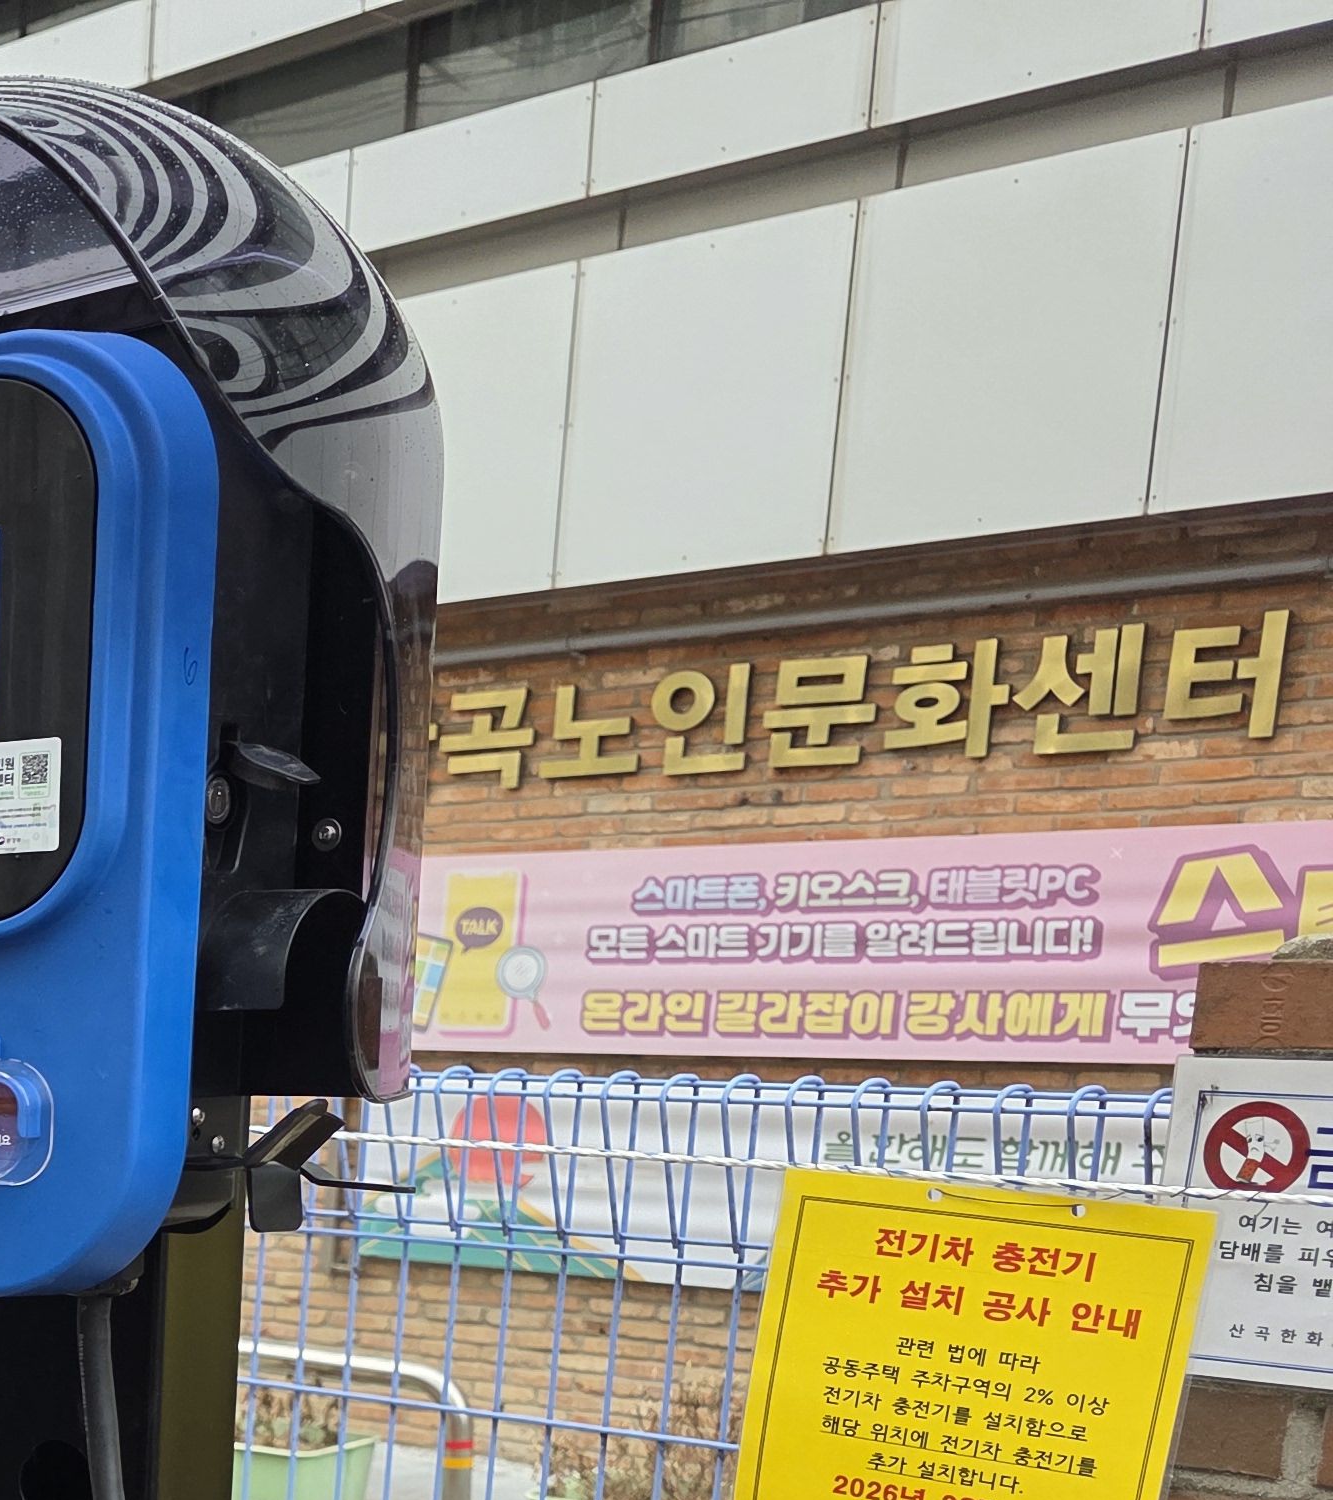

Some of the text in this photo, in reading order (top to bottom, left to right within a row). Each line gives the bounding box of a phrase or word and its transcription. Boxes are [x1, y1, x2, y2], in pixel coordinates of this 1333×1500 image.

[429, 609, 1290, 789] 곡노인문화센터
[633, 864, 1092, 912] 스마트폰, 키오스크, 태블릿PC
[588, 920, 1093, 959] 모든 스마트 기기를 알려드립니다!
[583, 992, 704, 1034] 온라인
[714, 992, 895, 1036] 길라잡이
[907, 992, 1107, 1037] 강사에게
[1238, 1214, 1303, 1235] 여기는
[874, 1228, 1097, 1282] 전기차 충전기
[1219, 1240, 1285, 1264] 담배를
[817, 1270, 1142, 1340] 추가 설치 공사 안내
[1253, 1273, 1298, 1295] 침을
[896, 1336, 1041, 1375] 관련 법에 따라
[822, 1356, 1110, 1416] 공동주택 주차구역의 2% 이상
[823, 1385, 1088, 1442] 전기차 충전기를 설치함으로
[822, 1414, 1098, 1477] 해당 위치에 전기차 충전기를
[867, 1452, 1024, 1494] 추가 설치합니다.
